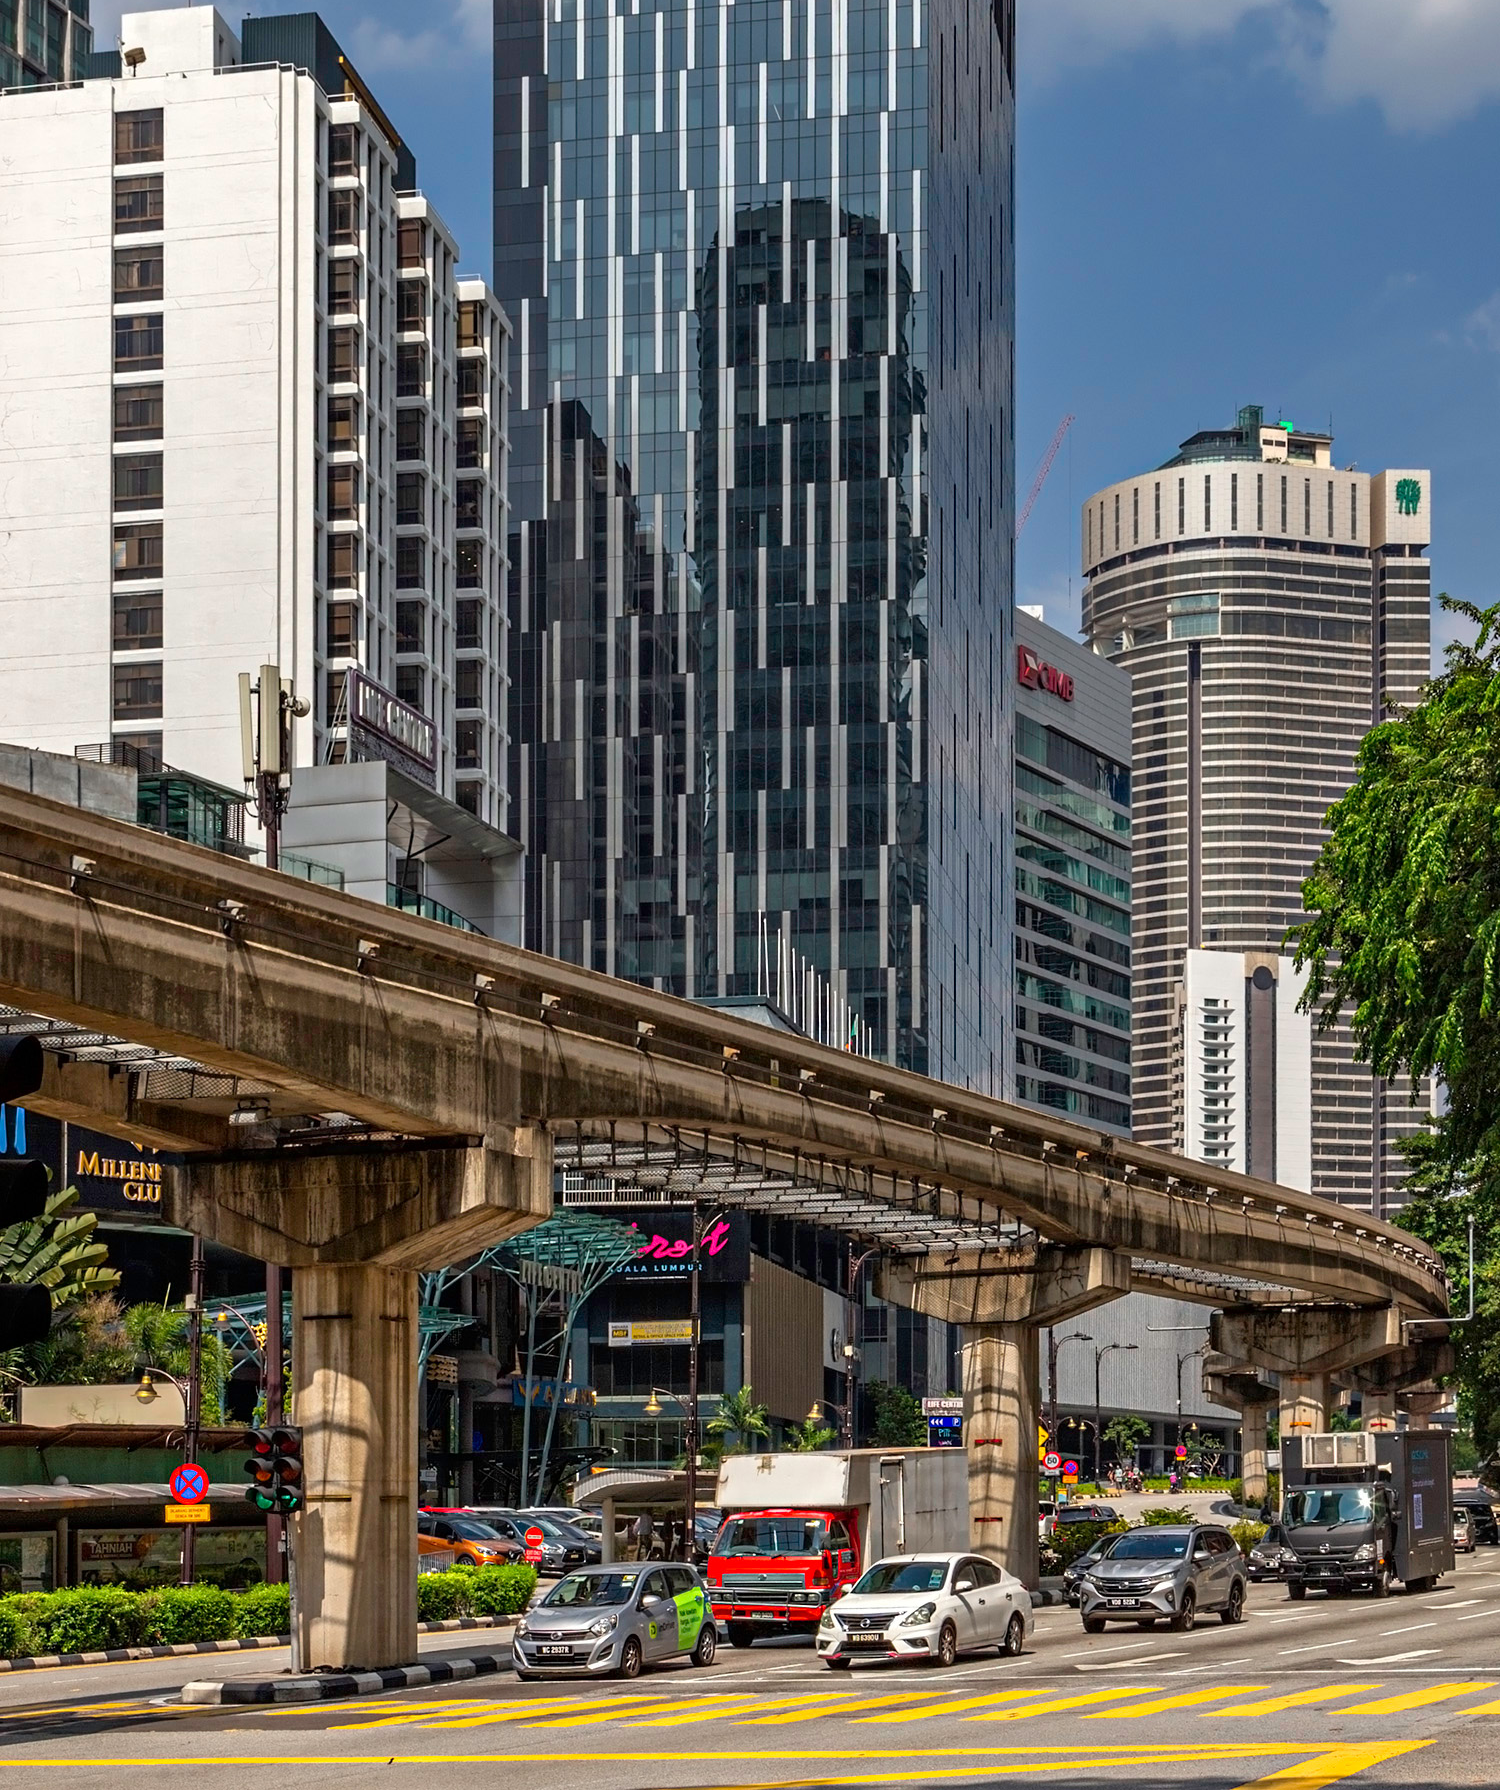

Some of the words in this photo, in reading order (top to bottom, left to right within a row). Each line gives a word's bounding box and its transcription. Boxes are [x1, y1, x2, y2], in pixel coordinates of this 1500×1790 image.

[1038, 662, 1075, 702] CIMB
[358, 681, 387, 732] LIFE
[386, 701, 434, 762] CENTRE
[1046, 1456, 1058, 1465] 50
[89, 1542, 133, 1554] TAHNIAH
